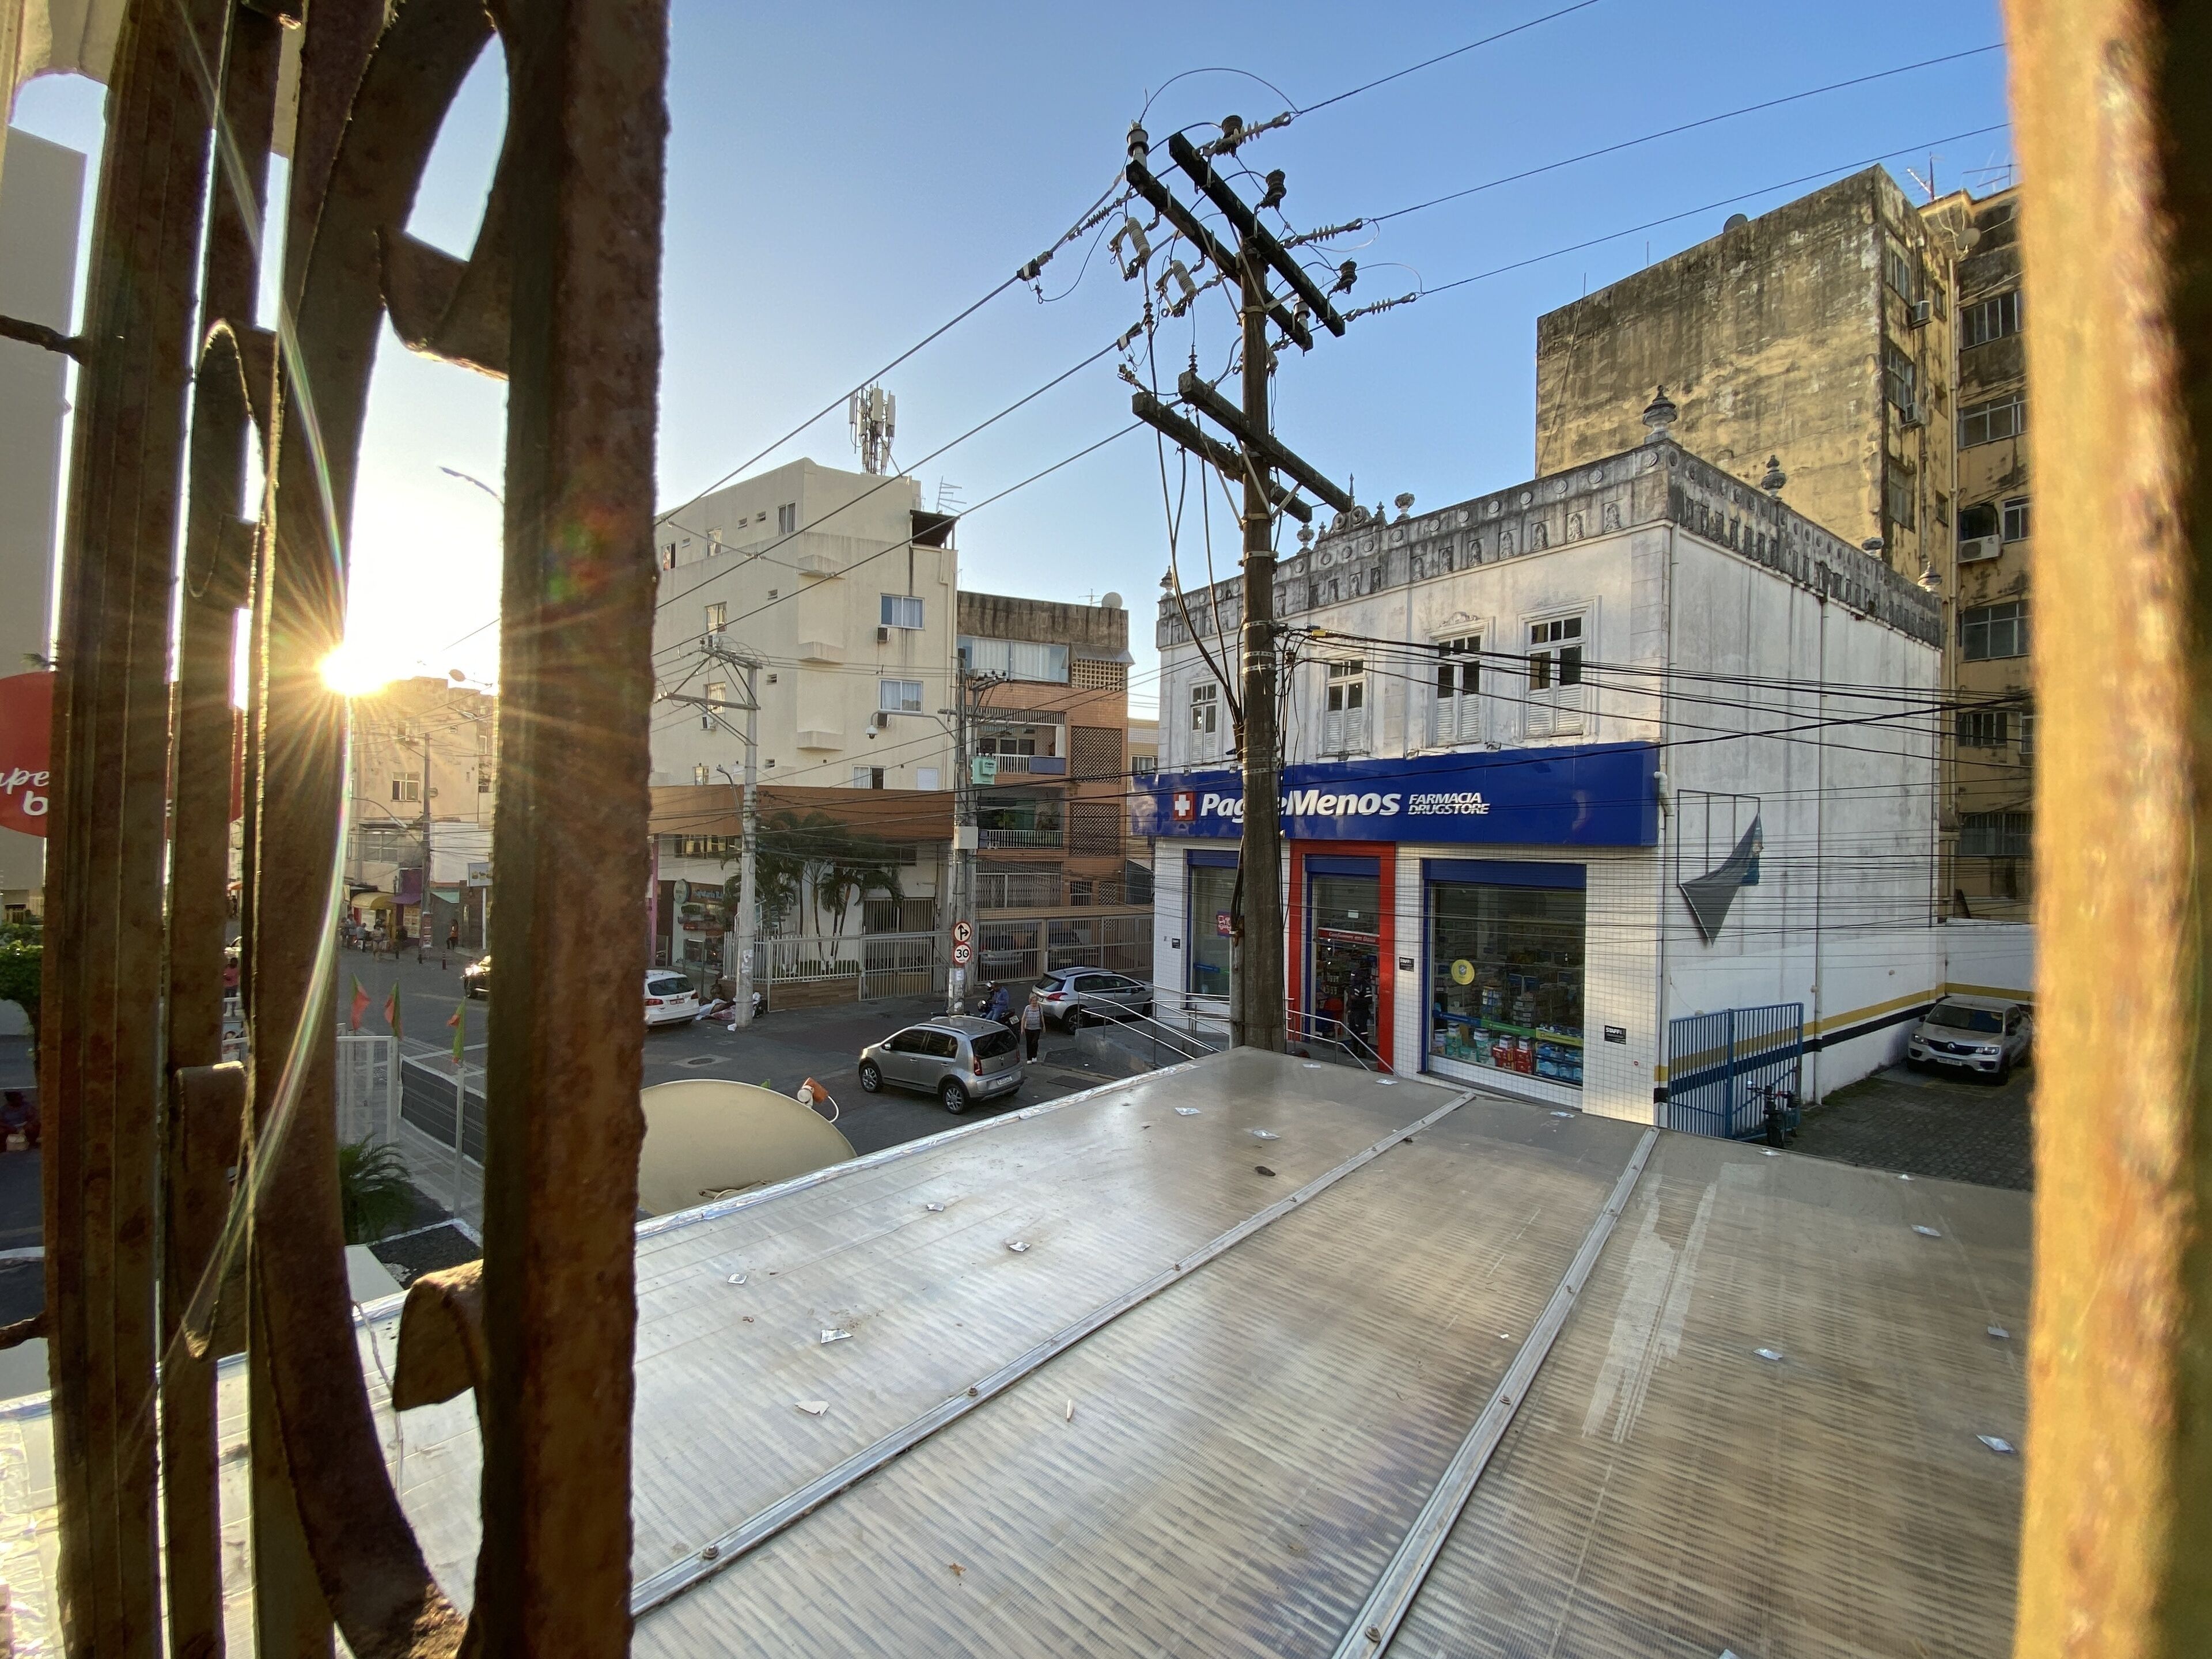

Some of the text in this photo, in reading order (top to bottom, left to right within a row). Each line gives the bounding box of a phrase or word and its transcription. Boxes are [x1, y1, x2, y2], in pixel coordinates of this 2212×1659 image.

[1408, 792, 1482, 804] FARMACIA
[1408, 804, 1491, 815] DRUGSTORE
[956, 949, 969, 958] 30
